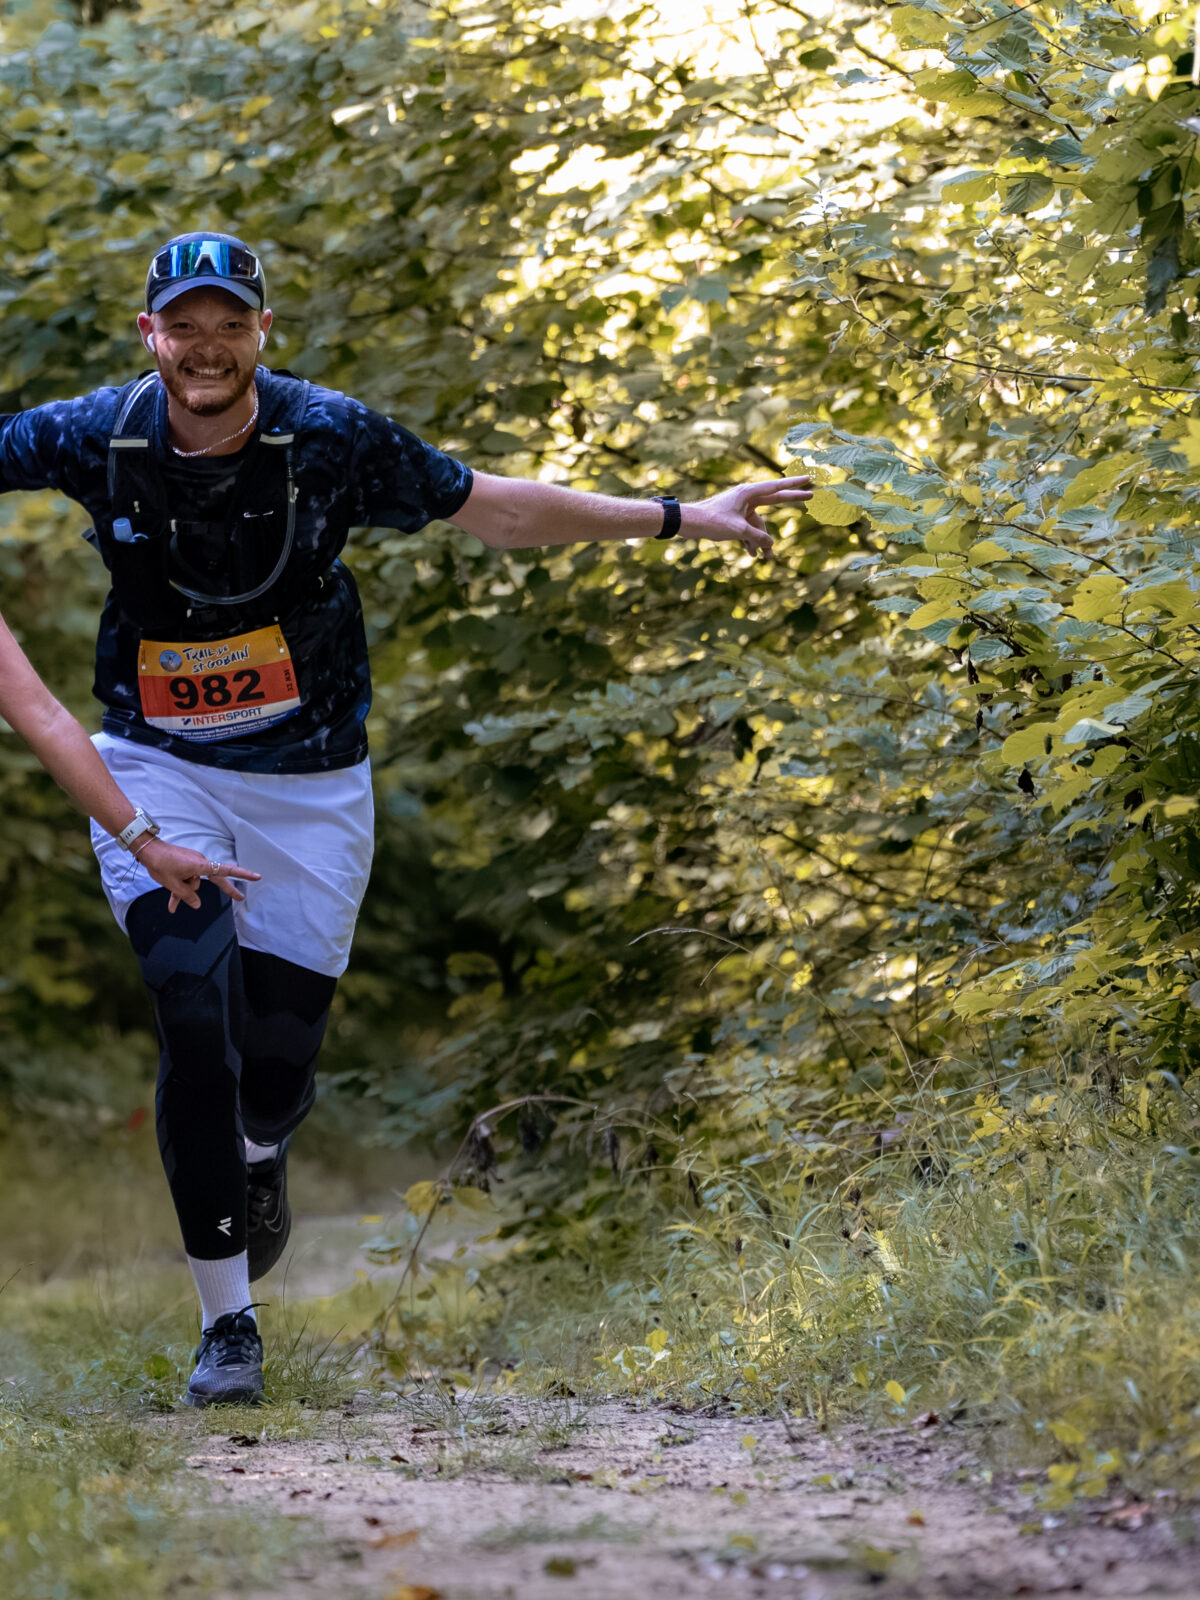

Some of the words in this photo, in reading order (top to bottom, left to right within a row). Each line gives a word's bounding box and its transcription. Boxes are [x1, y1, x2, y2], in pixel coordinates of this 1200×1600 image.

[182, 647, 216, 662] TRAIL
[206, 644, 250, 669] GOBAIN
[169, 669, 266, 710] 982
[192, 707, 263, 726] INTERSPORT
